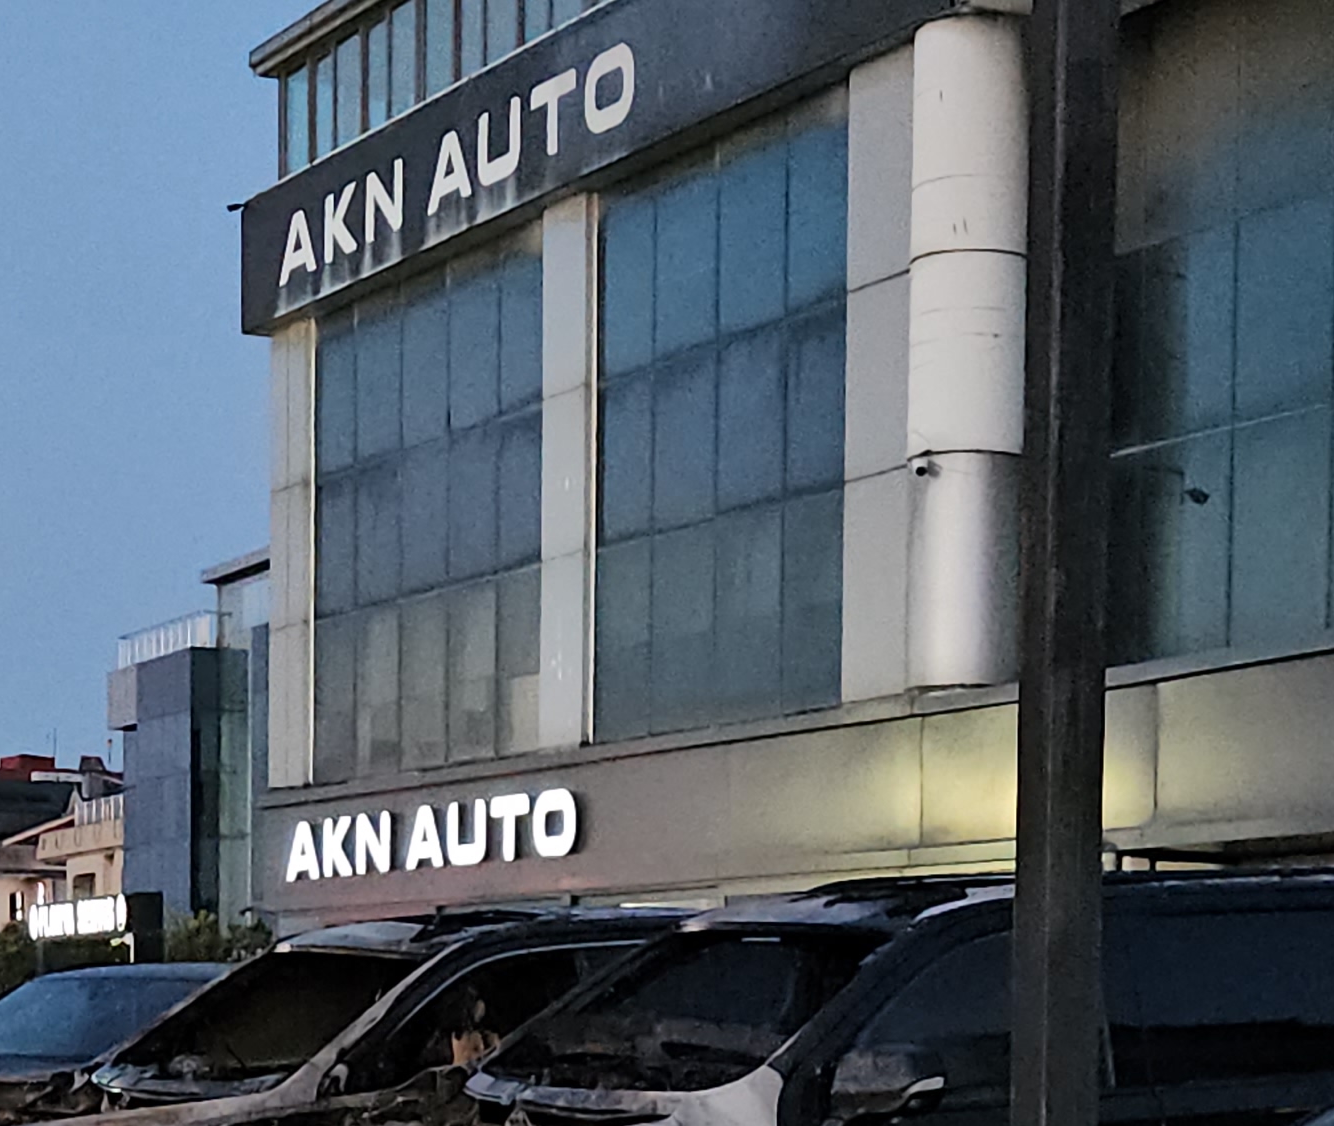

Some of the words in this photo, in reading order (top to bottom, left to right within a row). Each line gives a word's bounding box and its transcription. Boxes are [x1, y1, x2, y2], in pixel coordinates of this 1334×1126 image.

[279, 158, 403, 287] AKN
[427, 42, 635, 216] AUTO
[286, 810, 393, 883] AKN
[406, 788, 577, 872] AUTO
